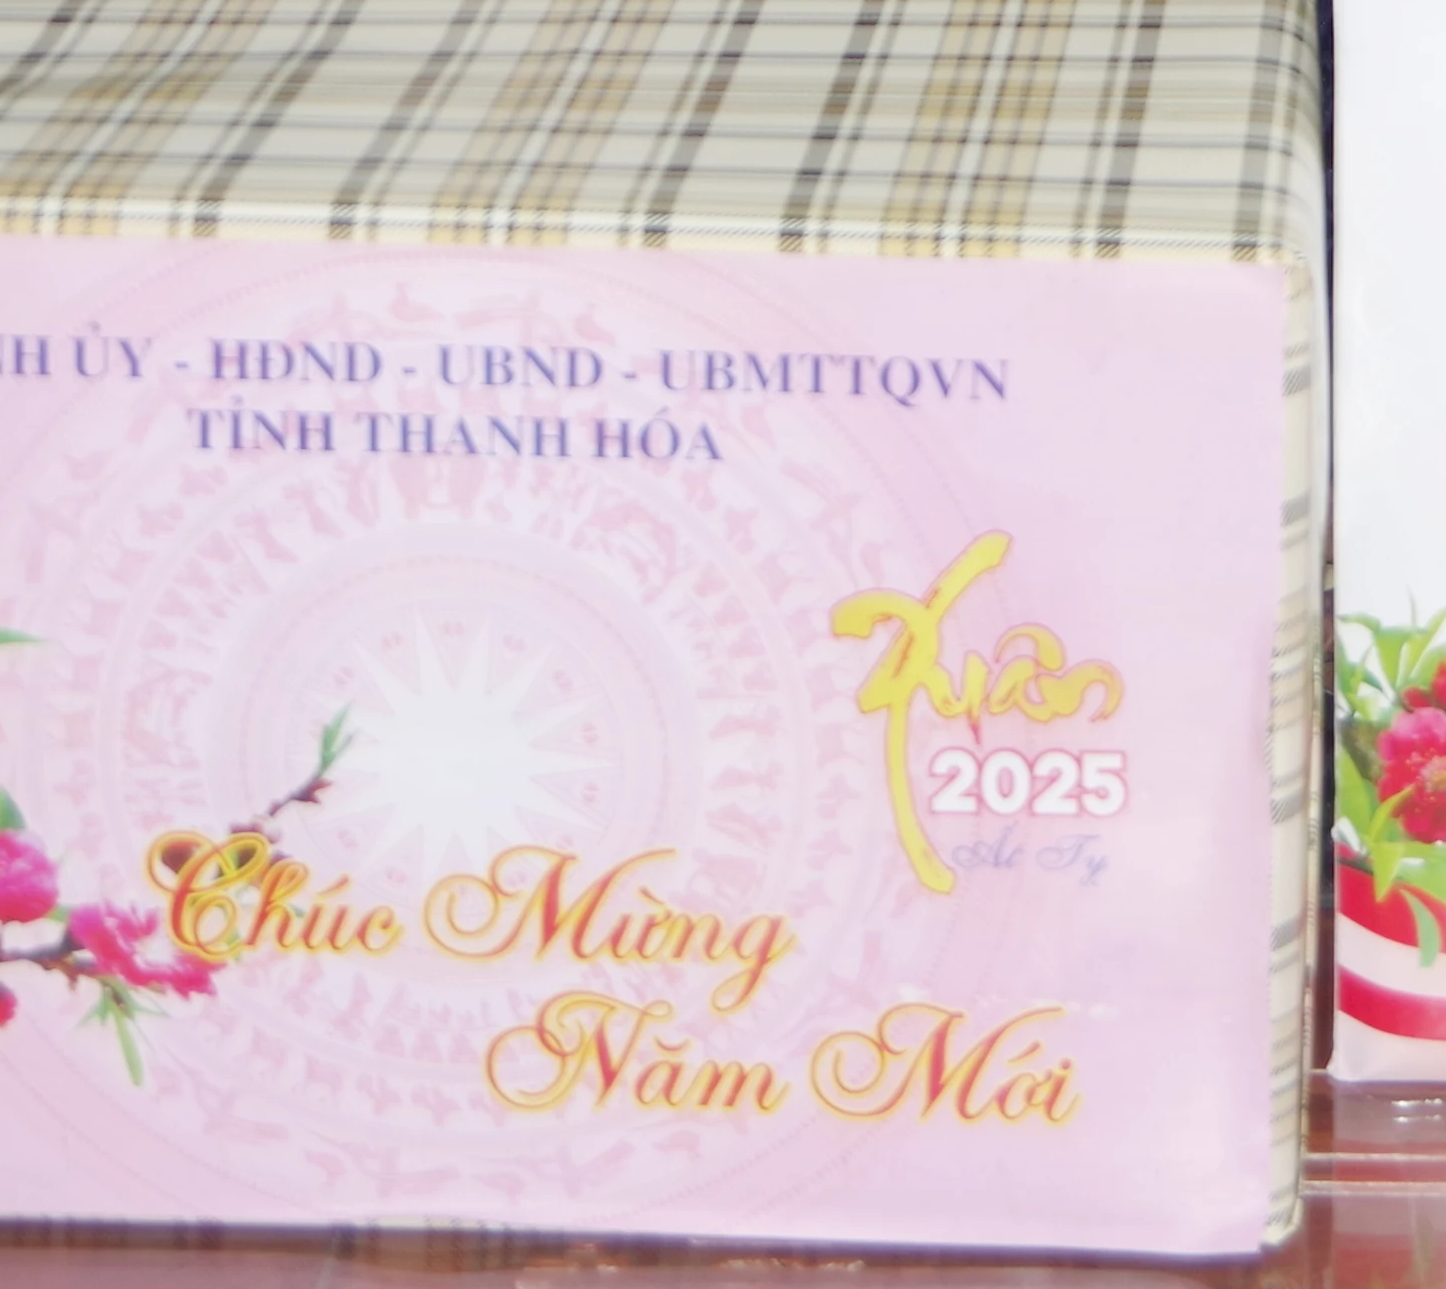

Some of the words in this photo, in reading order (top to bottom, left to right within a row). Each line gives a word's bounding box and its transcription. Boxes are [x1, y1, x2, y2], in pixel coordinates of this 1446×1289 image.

[71, 320, 153, 378] ỦY
[210, 336, 383, 382] HĐND
[437, 343, 603, 389] UBND
[657, 348, 1009, 407] UBMTTQVN
[186, 396, 337, 452] TỈNH
[355, 410, 572, 458] THANH
[592, 405, 724, 461] HÓA
[829, 528, 1125, 895] Xuân
[927, 745, 1128, 818] 2025
[146, 828, 405, 962] Chúc
[423, 843, 799, 1015] Mừng
[484, 989, 792, 1114] Năm
[808, 1001, 1084, 1124] Mới
